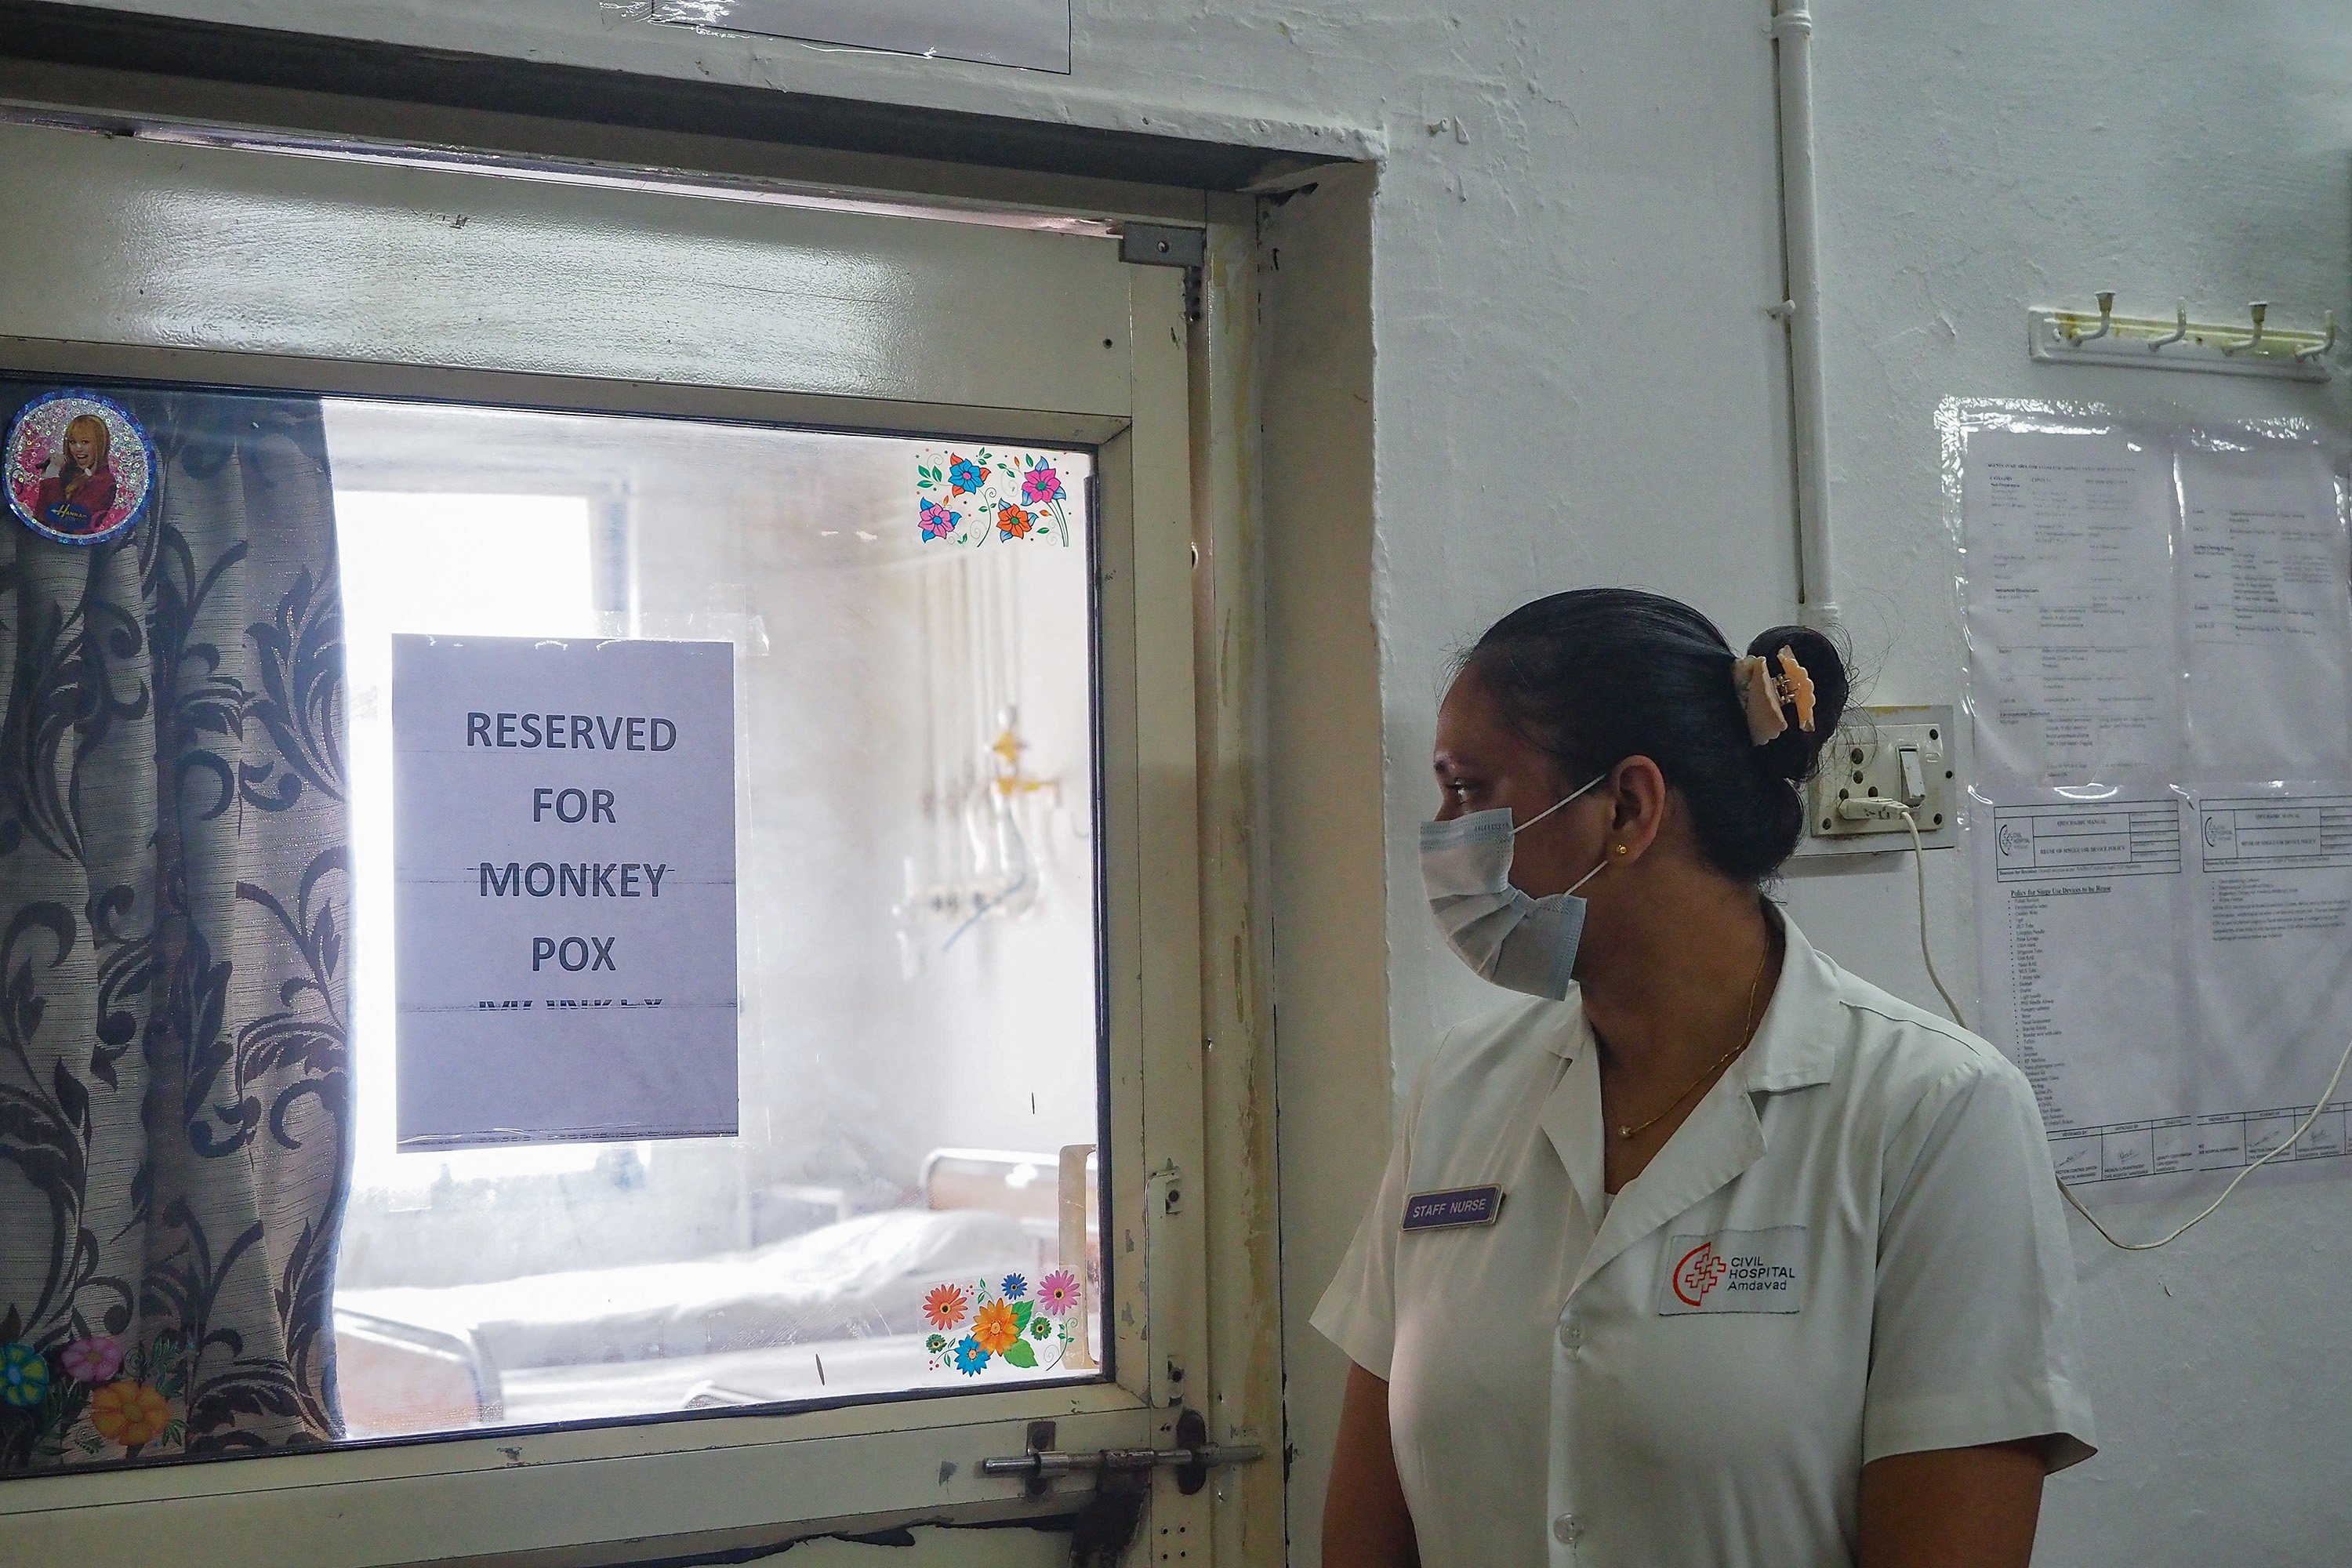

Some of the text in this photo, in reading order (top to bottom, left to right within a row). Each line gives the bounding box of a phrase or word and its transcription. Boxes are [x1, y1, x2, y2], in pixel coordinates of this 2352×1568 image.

[466, 712, 677, 751] RESERVED
[533, 788, 616, 823] FOR
[480, 862, 666, 897] MONKEY
[532, 937, 616, 971] POX
[1413, 1198, 1486, 1218] STAFF NURSE
[1729, 1267, 1795, 1279] HOSPITAL
[1731, 1256, 1763, 1267] CIVIL
[1727, 1279, 1787, 1291] Amdavad
